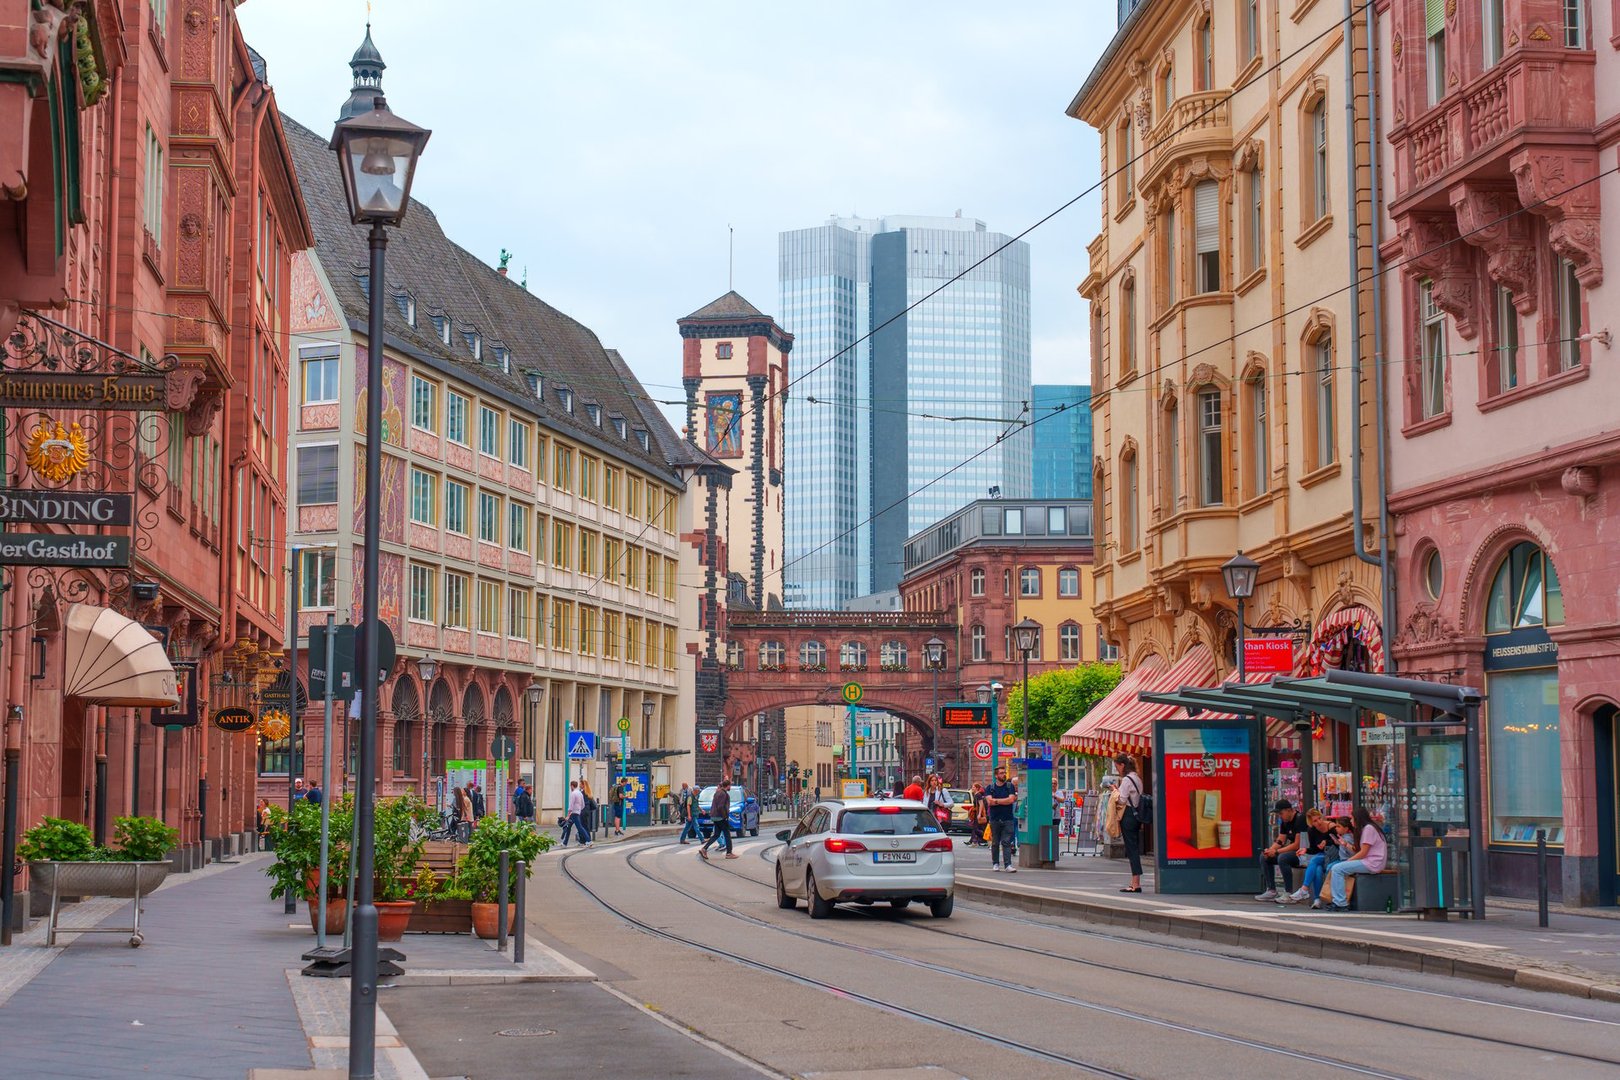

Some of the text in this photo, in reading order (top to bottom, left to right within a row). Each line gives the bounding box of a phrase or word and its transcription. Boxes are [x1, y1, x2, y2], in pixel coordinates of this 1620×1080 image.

[101, 376, 155, 403] Haus
[1266, 641, 1289, 650] Kiosk
[219, 715, 251, 724] ANTIK
[978, 745, 990, 755] 40
[1172, 759, 1200, 769] FIVE
